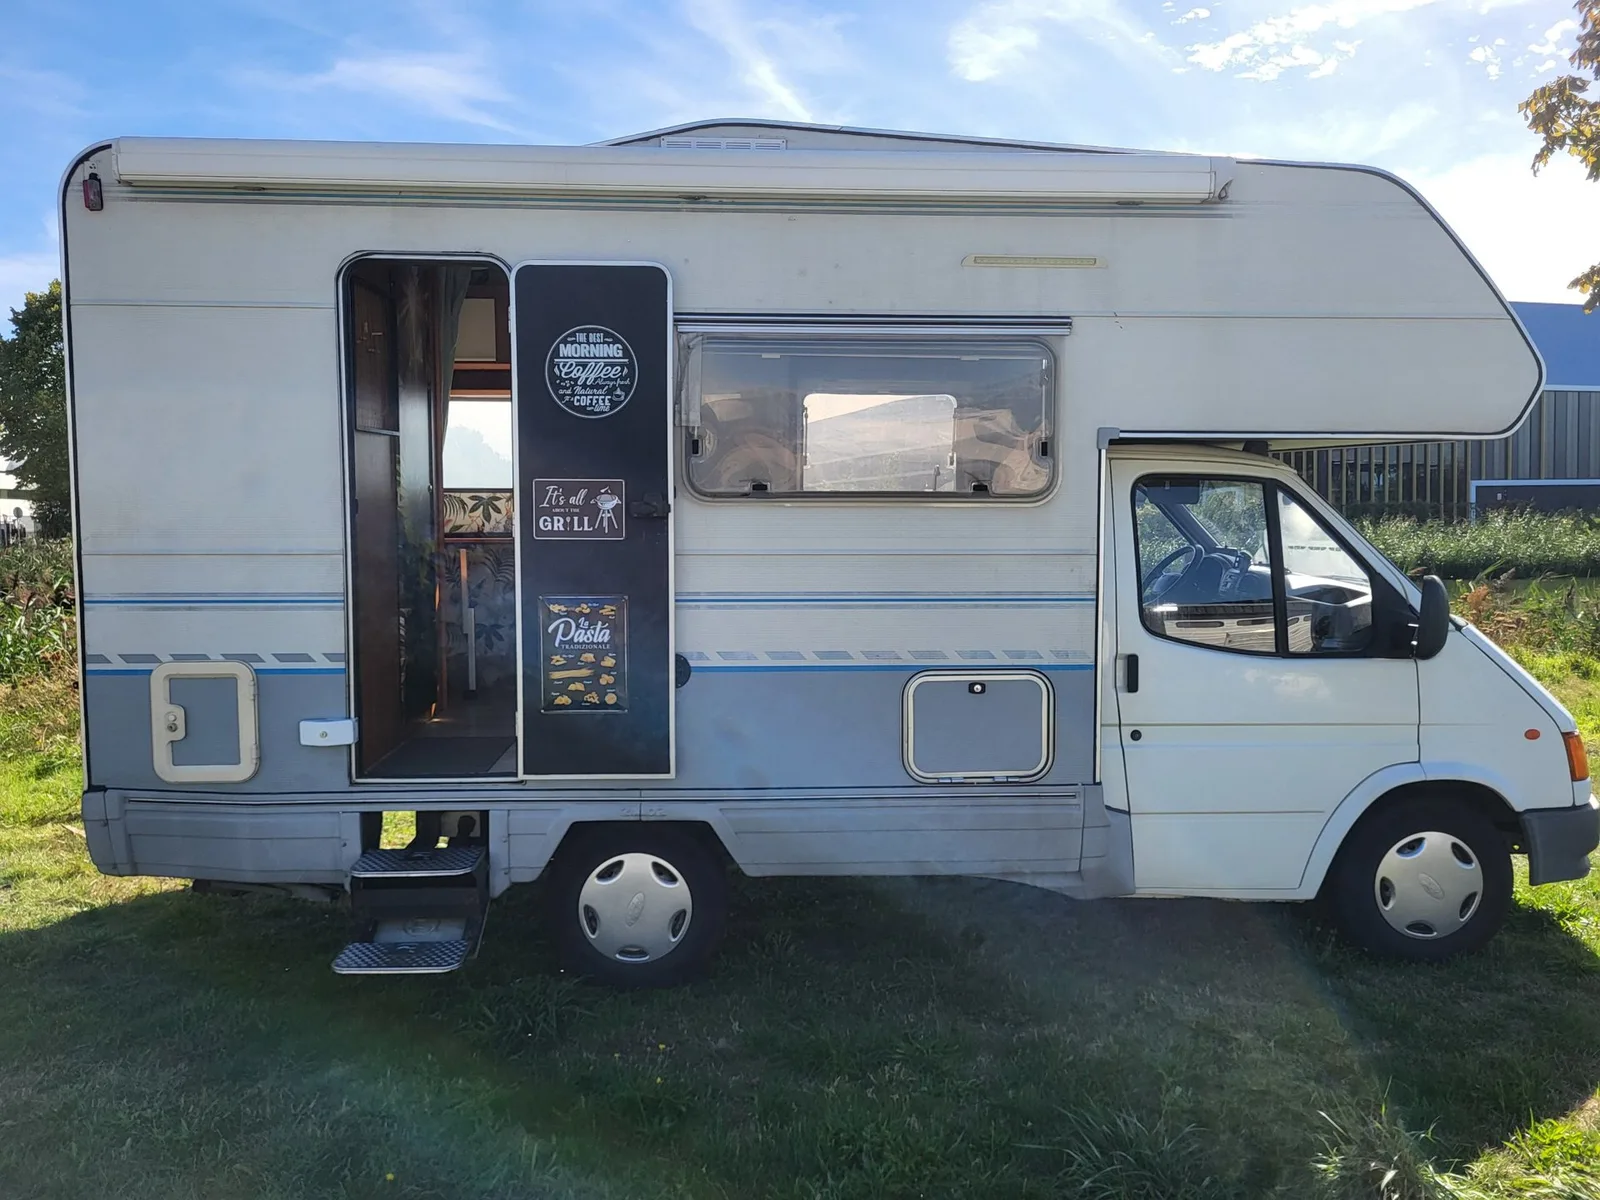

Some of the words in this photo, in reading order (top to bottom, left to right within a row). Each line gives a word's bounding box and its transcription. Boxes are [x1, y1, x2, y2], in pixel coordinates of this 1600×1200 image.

[576, 333, 587, 342] THE
[589, 333, 604, 342] BEST
[559, 343, 623, 357] MORNING
[559, 361, 622, 385] Coffee
[573, 386, 609, 395] Natural
[574, 395, 611, 406] COFFEE
[539, 485, 566, 507] It's
[569, 488, 588, 505] all
[578, 616, 590, 629] La
[547, 617, 611, 648] Pasta
